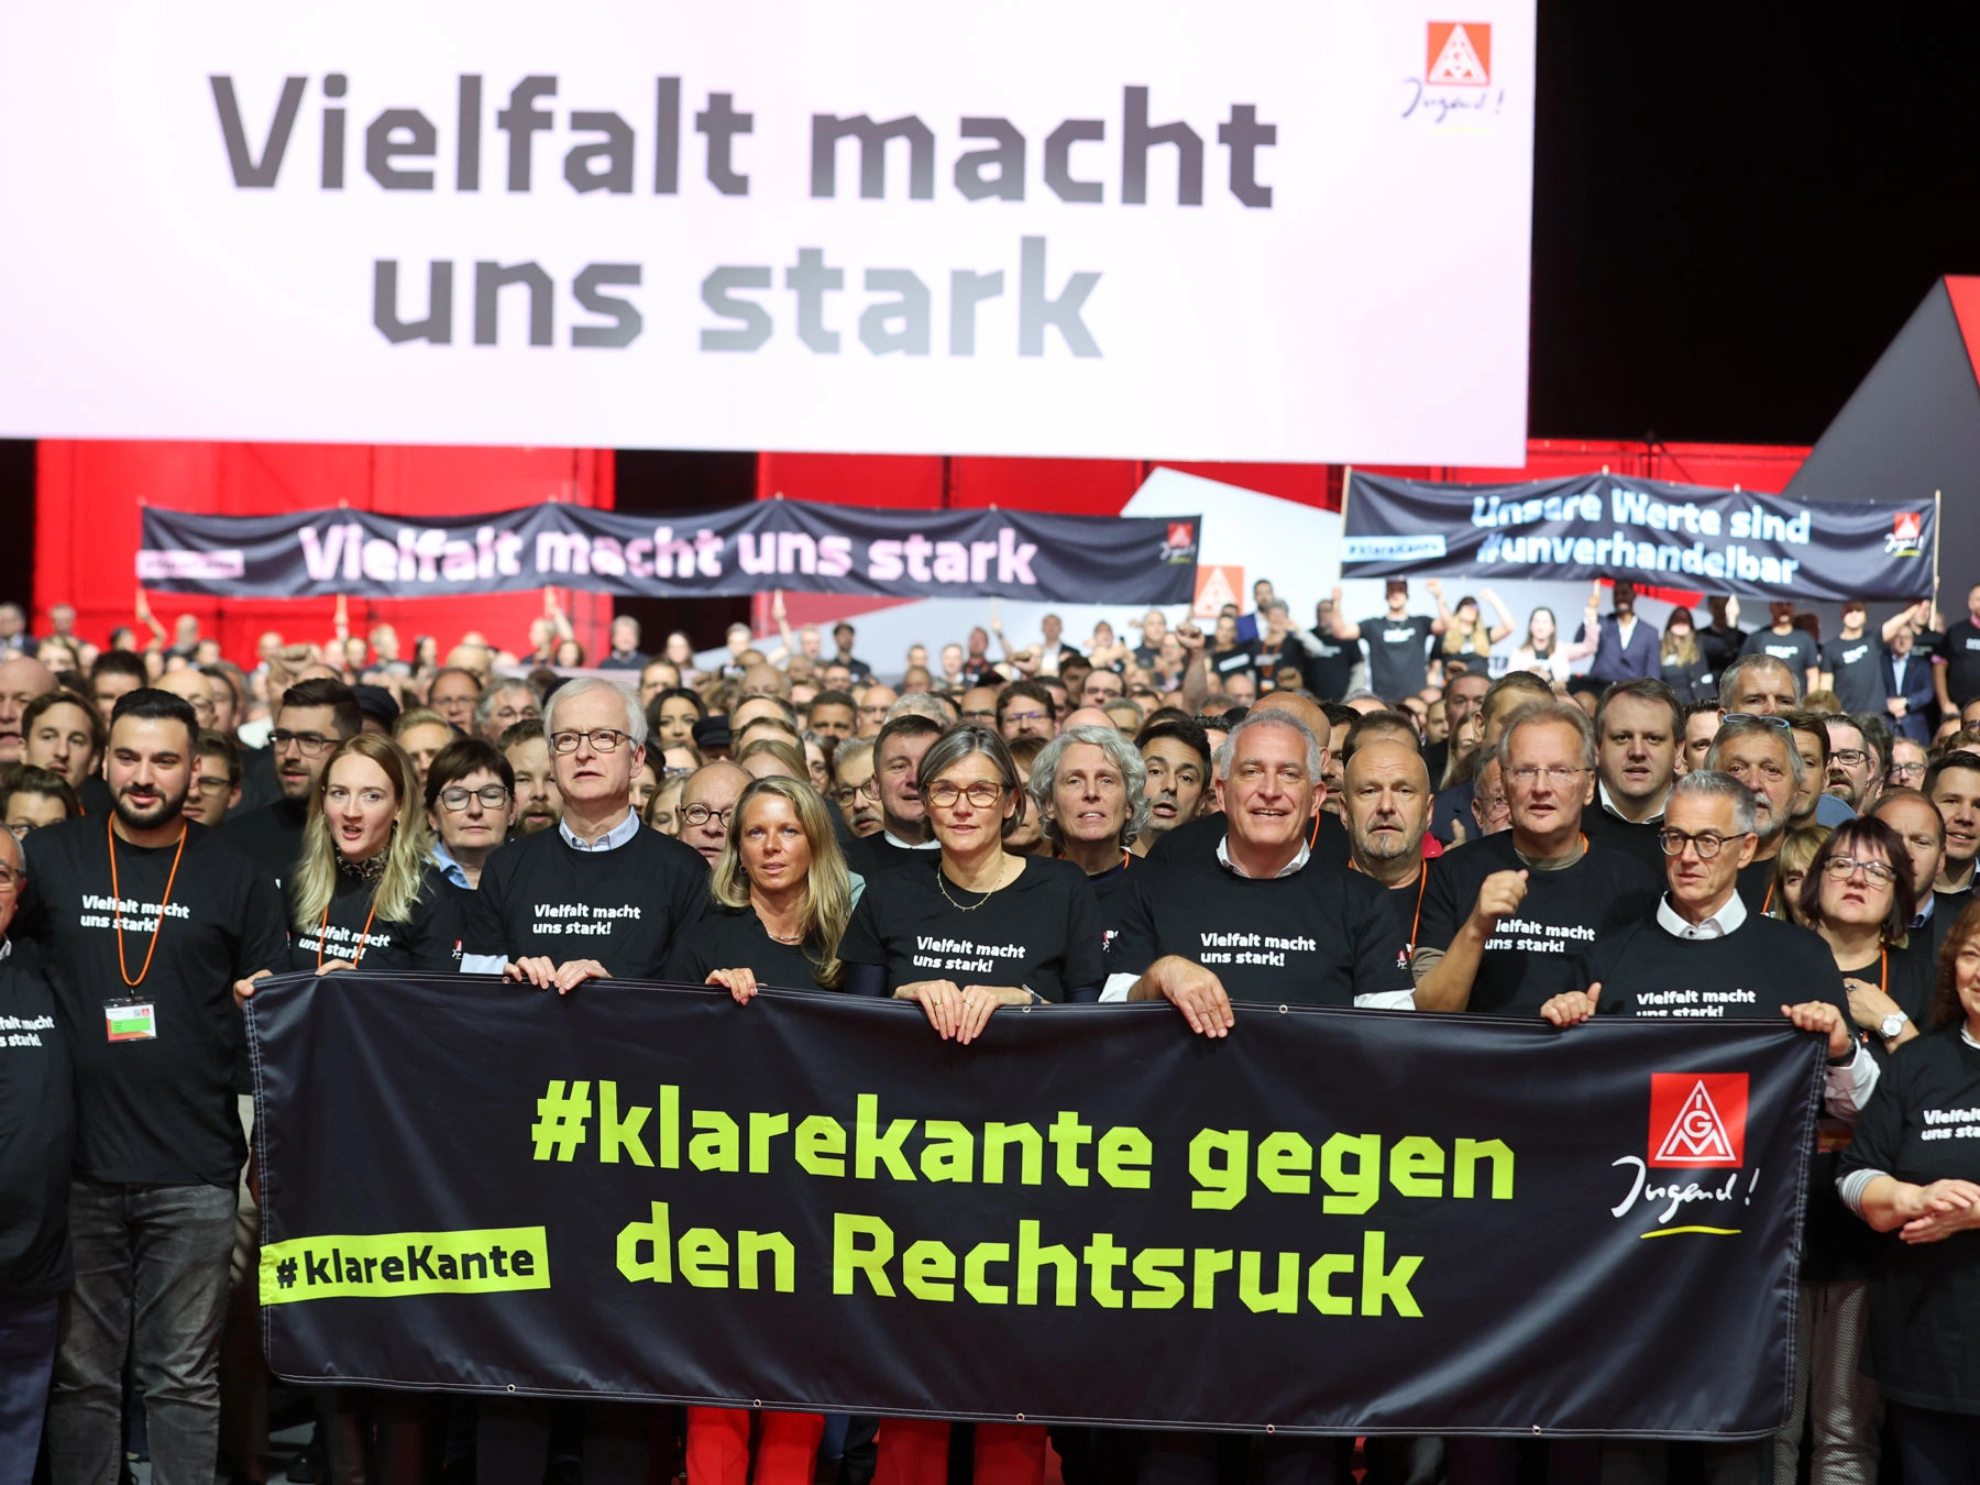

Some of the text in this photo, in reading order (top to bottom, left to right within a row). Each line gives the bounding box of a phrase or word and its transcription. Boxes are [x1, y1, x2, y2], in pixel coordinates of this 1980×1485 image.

[209, 73, 1277, 208] Vielfalt macht
[373, 236, 1104, 358] uns stark
[1472, 488, 1811, 544] Unsere Werte sind
[299, 524, 1038, 585] Vielfalt macht uns stark
[1476, 531, 1800, 584] #unverhandelbar
[82, 895, 190, 919] Vielfalt macht
[534, 903, 641, 919] Vielfalt macht
[80, 915, 110, 928] uns
[532, 921, 612, 935] uns stark!
[1495, 919, 1596, 941] ielfalt macht
[917, 935, 1026, 958] Vielfalt macht
[1201, 933, 1316, 951] Vielfalt macht
[1484, 938, 1565, 953] uns stark!
[913, 955, 993, 973] uns stark!
[1201, 951, 1285, 966] uns stark!
[1637, 989, 1756, 1005] Vielfalt macht
[1921, 1128, 1952, 1141] uns
[532, 1079, 1515, 1214] #klarekante gegen
[1611, 1155, 1760, 1224] Jugend!
[276, 1243, 534, 1289] #klareKante
[616, 1201, 1425, 1317] den Rechtsruck
